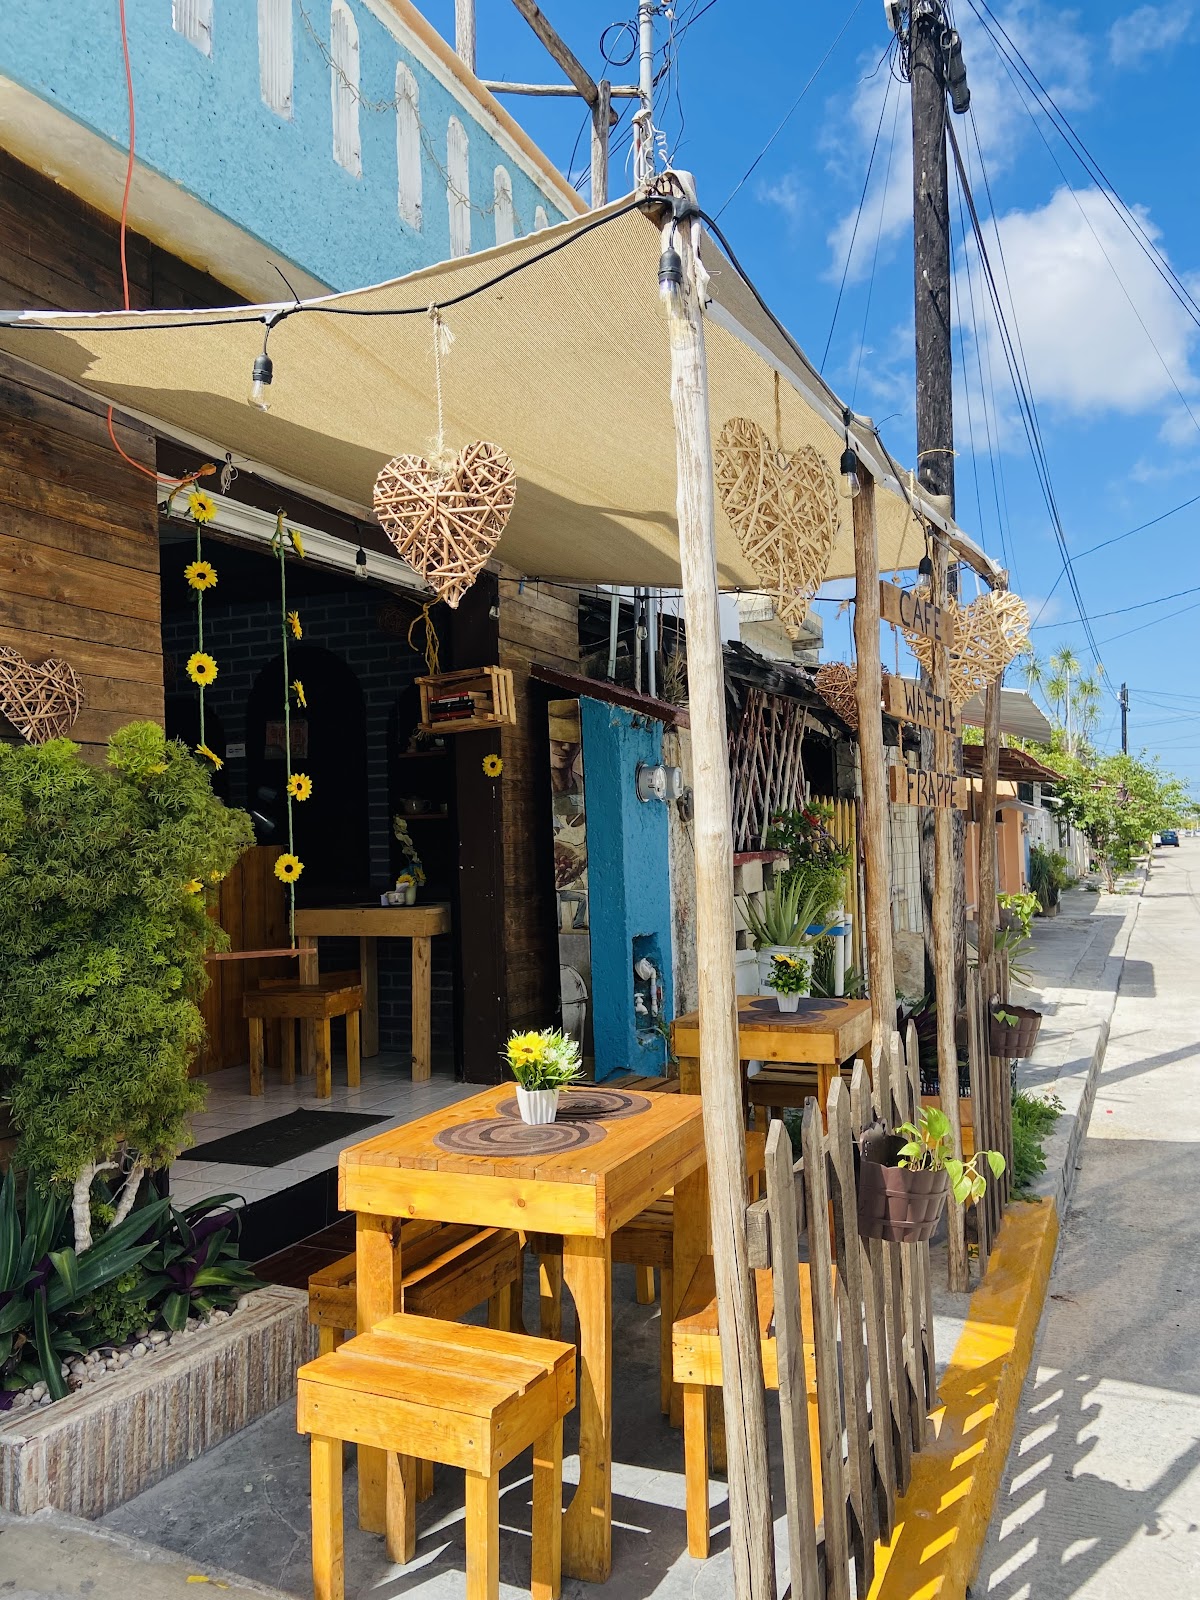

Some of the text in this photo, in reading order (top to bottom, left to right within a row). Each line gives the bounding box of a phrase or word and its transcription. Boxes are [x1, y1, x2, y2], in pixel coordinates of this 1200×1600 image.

[900, 590, 942, 641] CAFE
[904, 681, 956, 734] WAFFLE
[907, 768, 957, 808] FRAPPE
